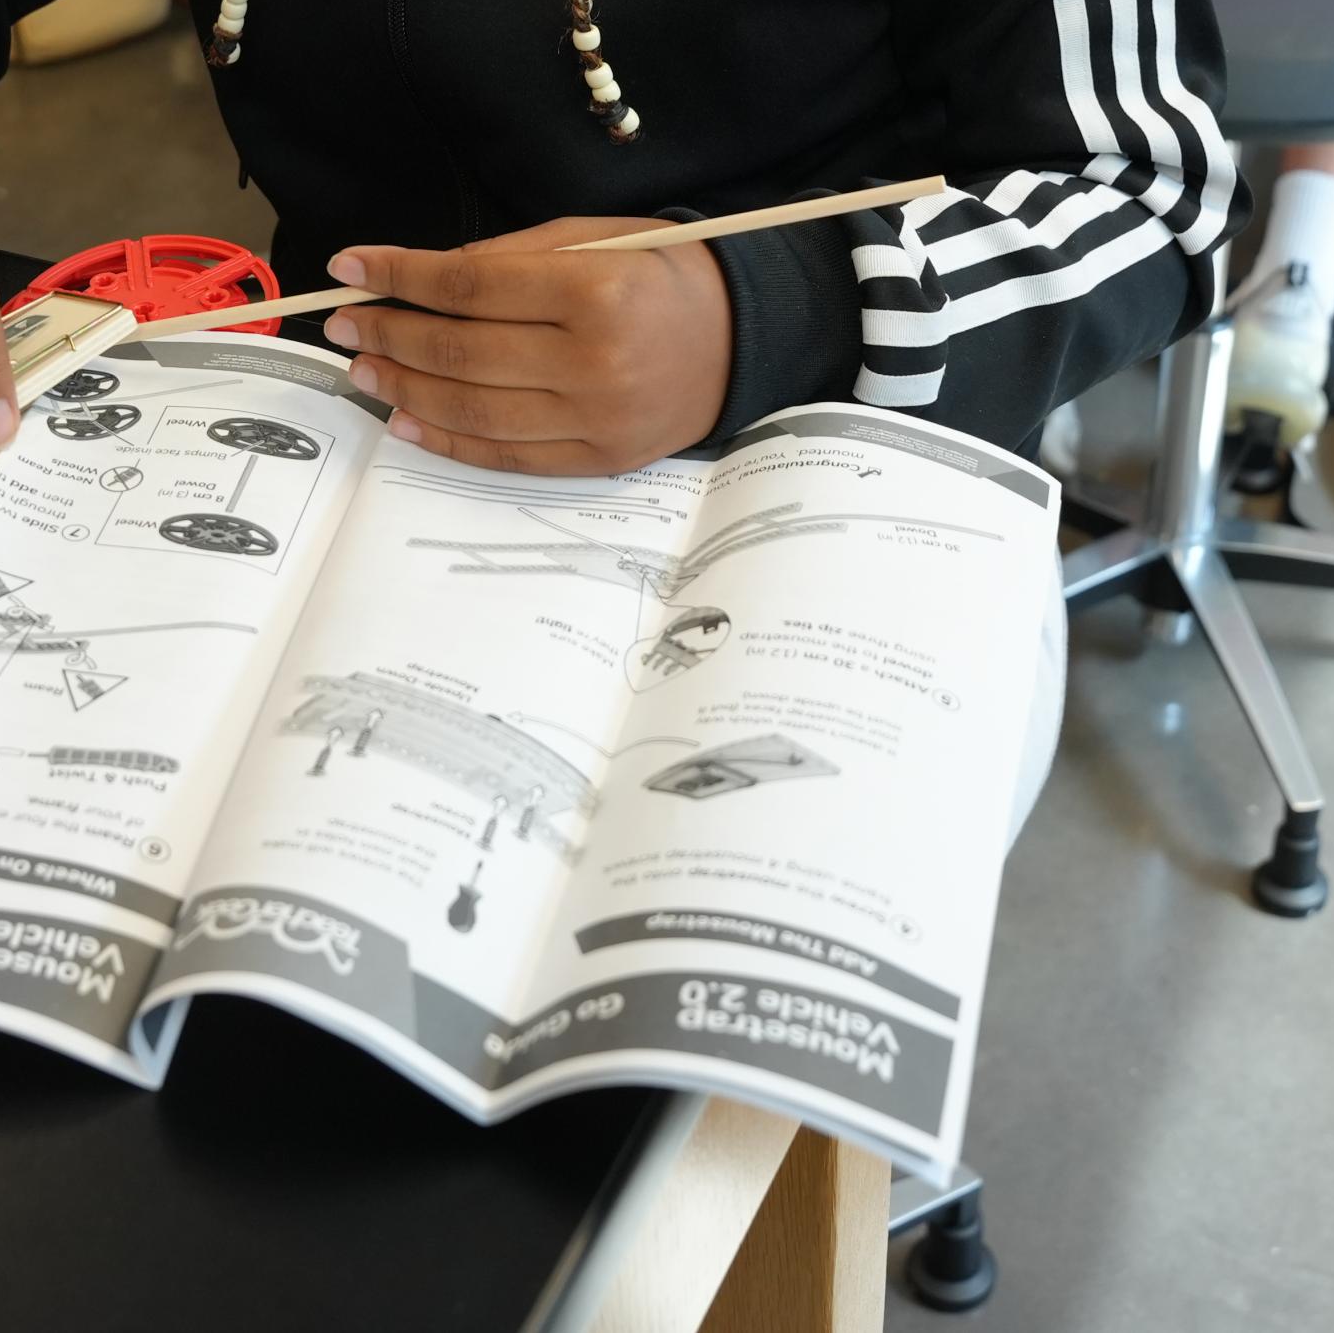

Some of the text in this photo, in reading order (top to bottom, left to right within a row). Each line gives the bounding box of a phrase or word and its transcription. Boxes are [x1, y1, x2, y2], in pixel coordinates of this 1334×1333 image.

[165, 417, 207, 428] Wheel
[154, 447, 181, 458] face
[183, 447, 228, 461] Bumps
[743, 450, 785, 467] You're
[795, 448, 864, 460] mounted.
[15, 453, 94, 486] Never Ream
[50, 457, 99, 475] Wheels
[737, 458, 861, 482] Congratulations!
[655, 469, 684, 482] add
[687, 474, 702, 485] to
[173, 479, 217, 491] Dowel
[623, 475, 701, 496] mousetrap
[9, 479, 75, 508] then add
[156, 487, 225, 503] 8 cm (3 in)
[9, 492, 67, 521] through
[20, 514, 60, 534] Slide
[113, 516, 158, 530] Wheel
[576, 510, 630, 523] Zip Ties
[894, 524, 937, 539] Dowel
[919, 537, 941, 548] cm
[943, 543, 961, 553] 30
[817, 622, 843, 636] zip
[847, 630, 889, 650] three
[738, 631, 933, 680] dowel to the mousetrap
[802, 650, 828, 663] cm
[832, 656, 855, 671] 30
[22, 681, 64, 697] Ream
[873, 668, 929, 695] Attach
[48, 767, 96, 783] Twist
[122, 775, 168, 793] Push
[52, 820, 79, 834] the
[83, 827, 135, 849] Ream
[33, 861, 117, 898] Wheels
[645, 912, 878, 976] Add The Mousetrap
[576, 992, 625, 1021] Go
[678, 980, 901, 1056] Vehicle 2.0
[675, 1005, 895, 1084] Mousetrap
